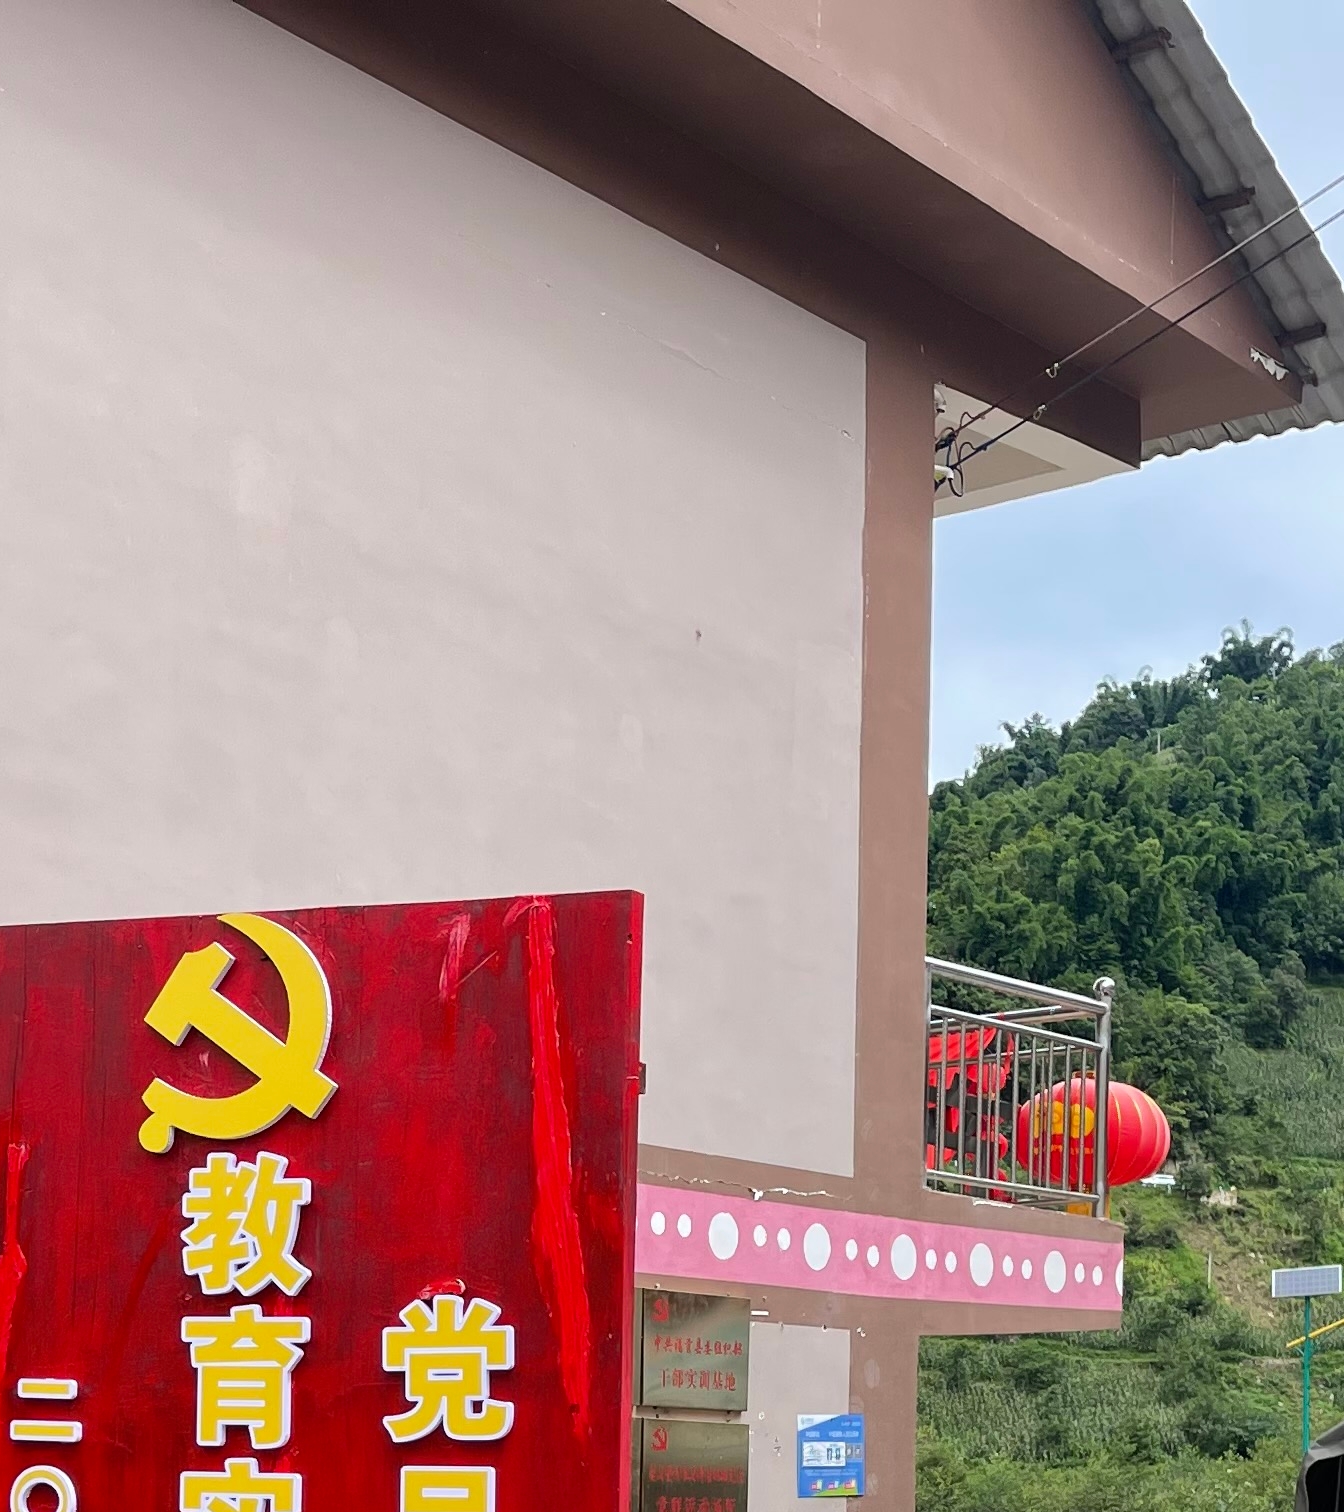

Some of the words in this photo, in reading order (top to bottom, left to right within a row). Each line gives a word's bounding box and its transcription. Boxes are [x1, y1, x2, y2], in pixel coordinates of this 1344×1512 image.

[658, 1367, 737, 1391] 干部实训基地
